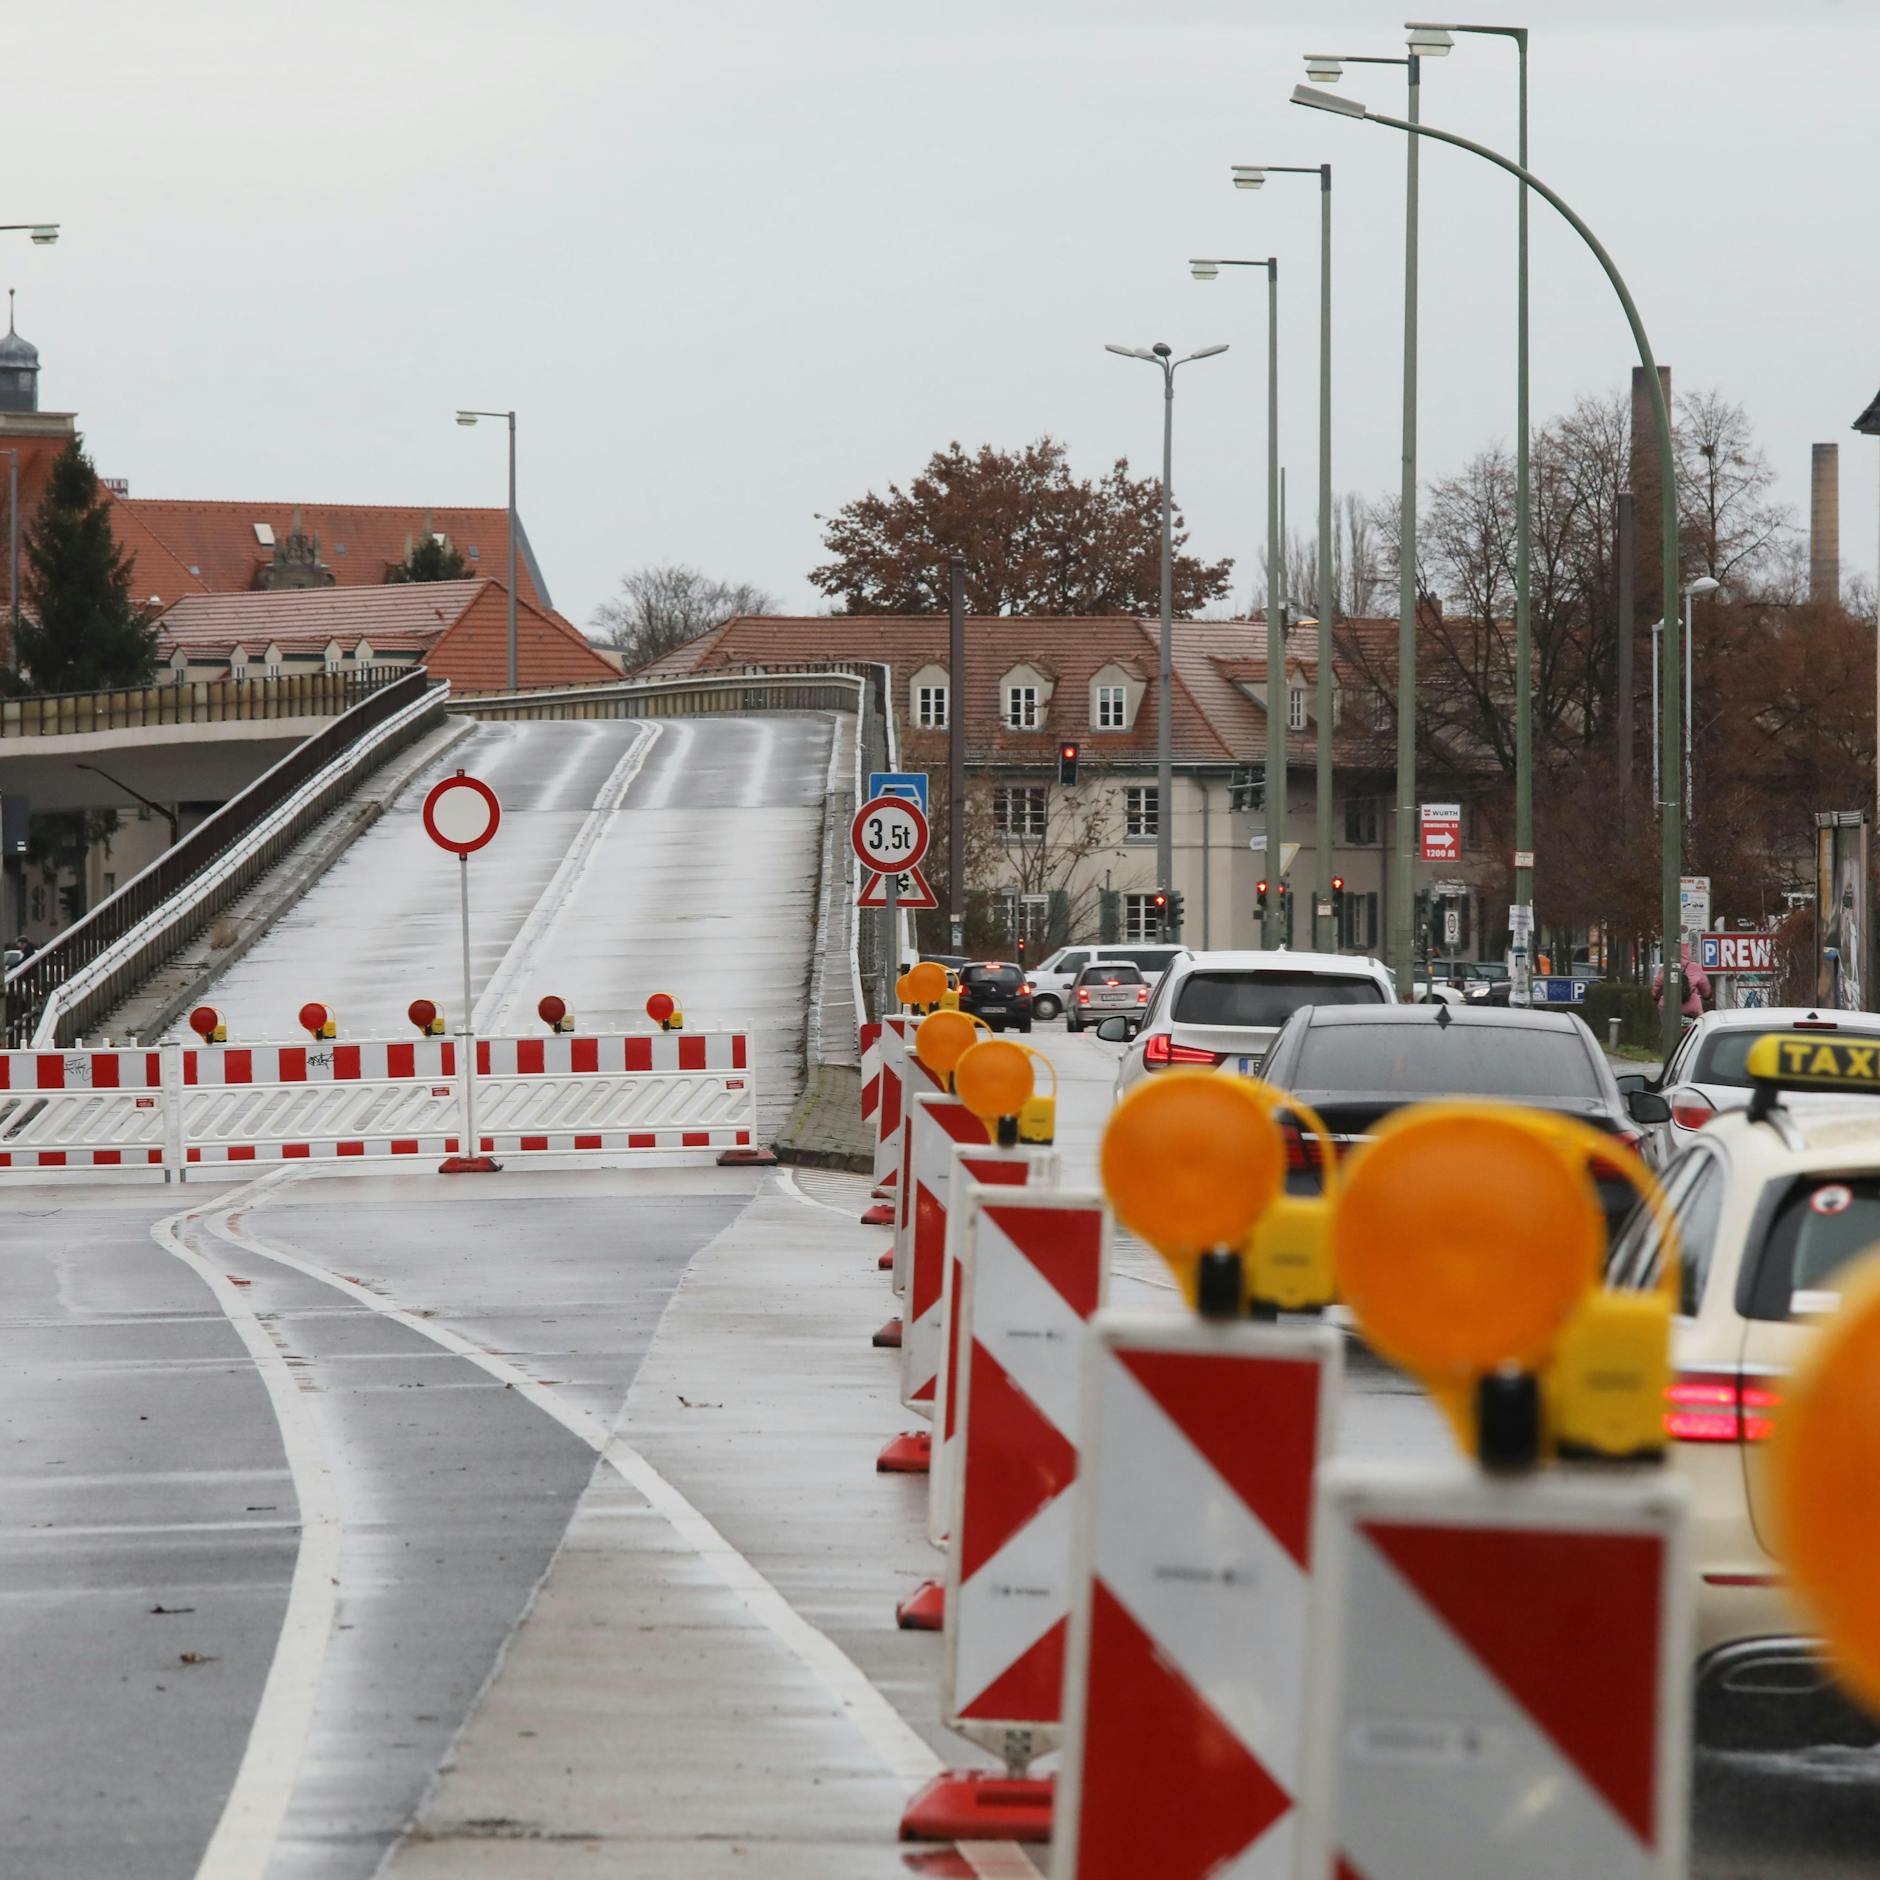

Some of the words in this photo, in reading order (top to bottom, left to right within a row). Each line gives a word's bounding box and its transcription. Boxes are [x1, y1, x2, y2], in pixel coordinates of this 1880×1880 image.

[869, 818, 911, 851] 3,5t
[1426, 849, 1446, 857] 1200
[1705, 943, 1716, 963] P
[1720, 938, 1779, 968] REW
[1783, 1043, 1880, 1079] TAX
